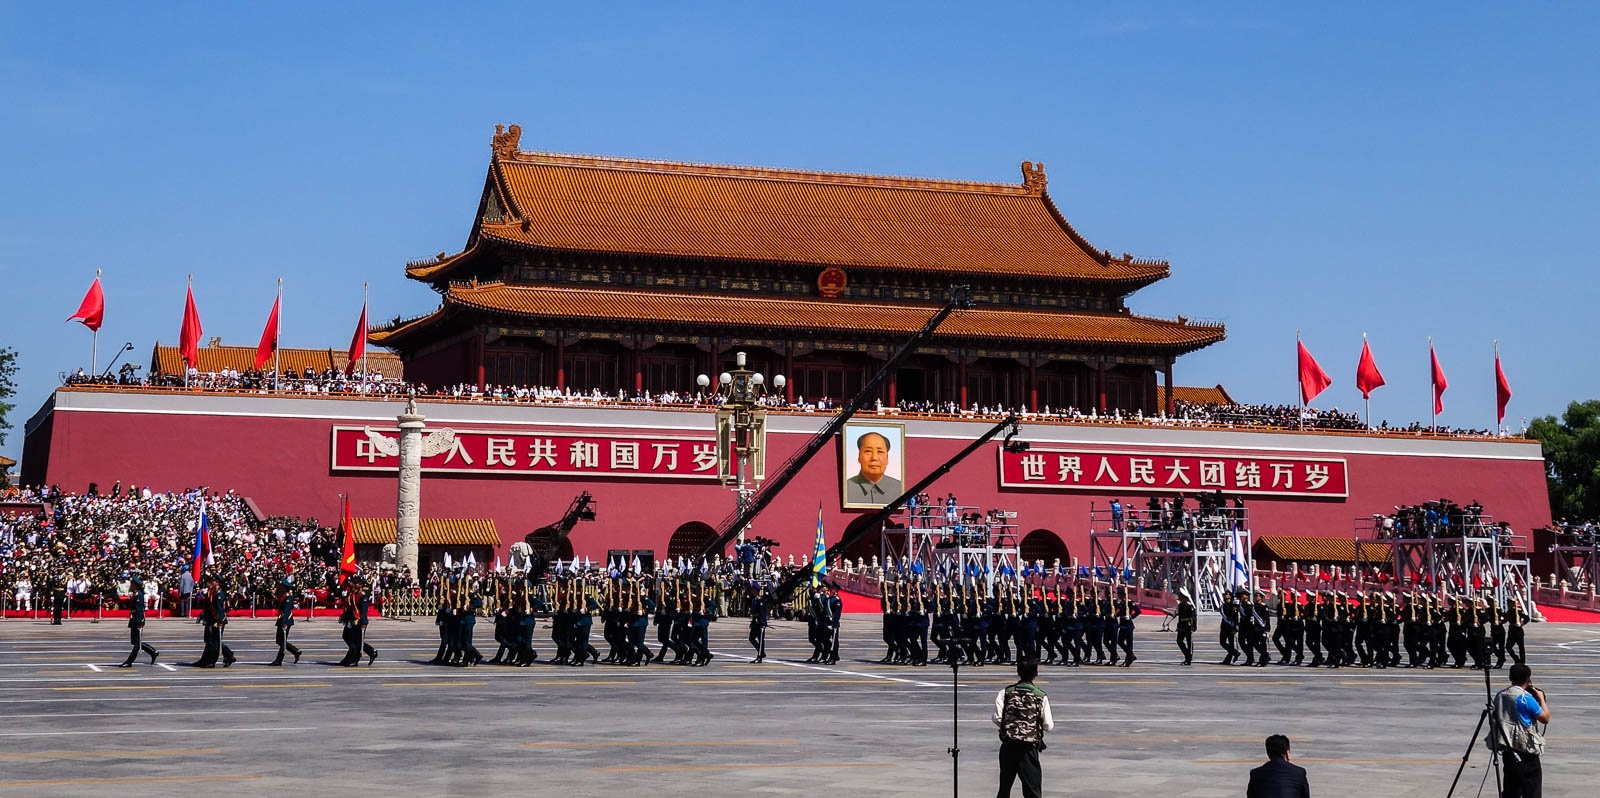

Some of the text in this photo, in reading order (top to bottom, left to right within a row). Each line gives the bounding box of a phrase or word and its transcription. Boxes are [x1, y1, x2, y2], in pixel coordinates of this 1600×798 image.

[356, 436, 718, 472] 中人民共和国万岁
[1020, 455, 1330, 490] 世界人民大团结万岁
